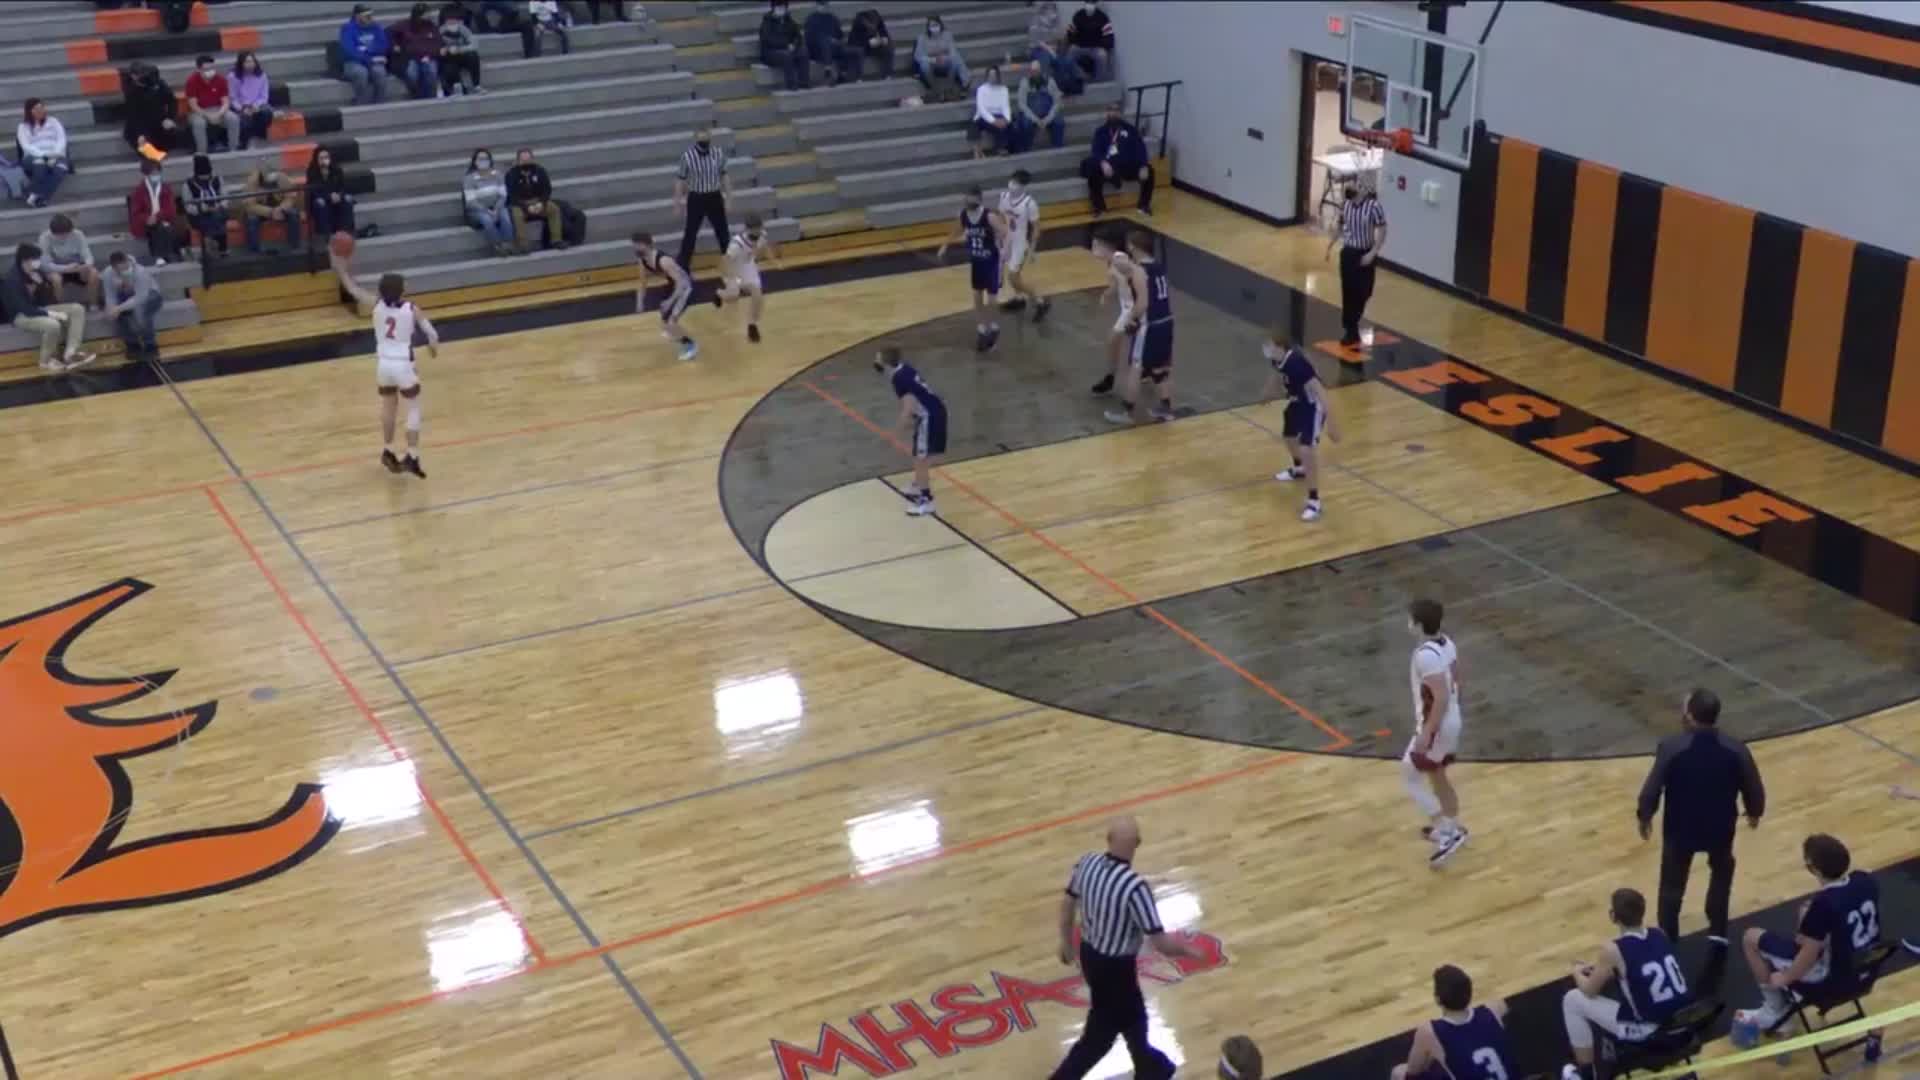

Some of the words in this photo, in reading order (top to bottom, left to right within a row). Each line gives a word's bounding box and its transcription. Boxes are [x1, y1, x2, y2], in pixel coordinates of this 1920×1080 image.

[1155, 275, 1167, 300] 11
[384, 315, 397, 340] 2
[1847, 900, 1879, 949] 22
[1641, 954, 1688, 1003] 20
[1472, 1046, 1508, 1080] 3
